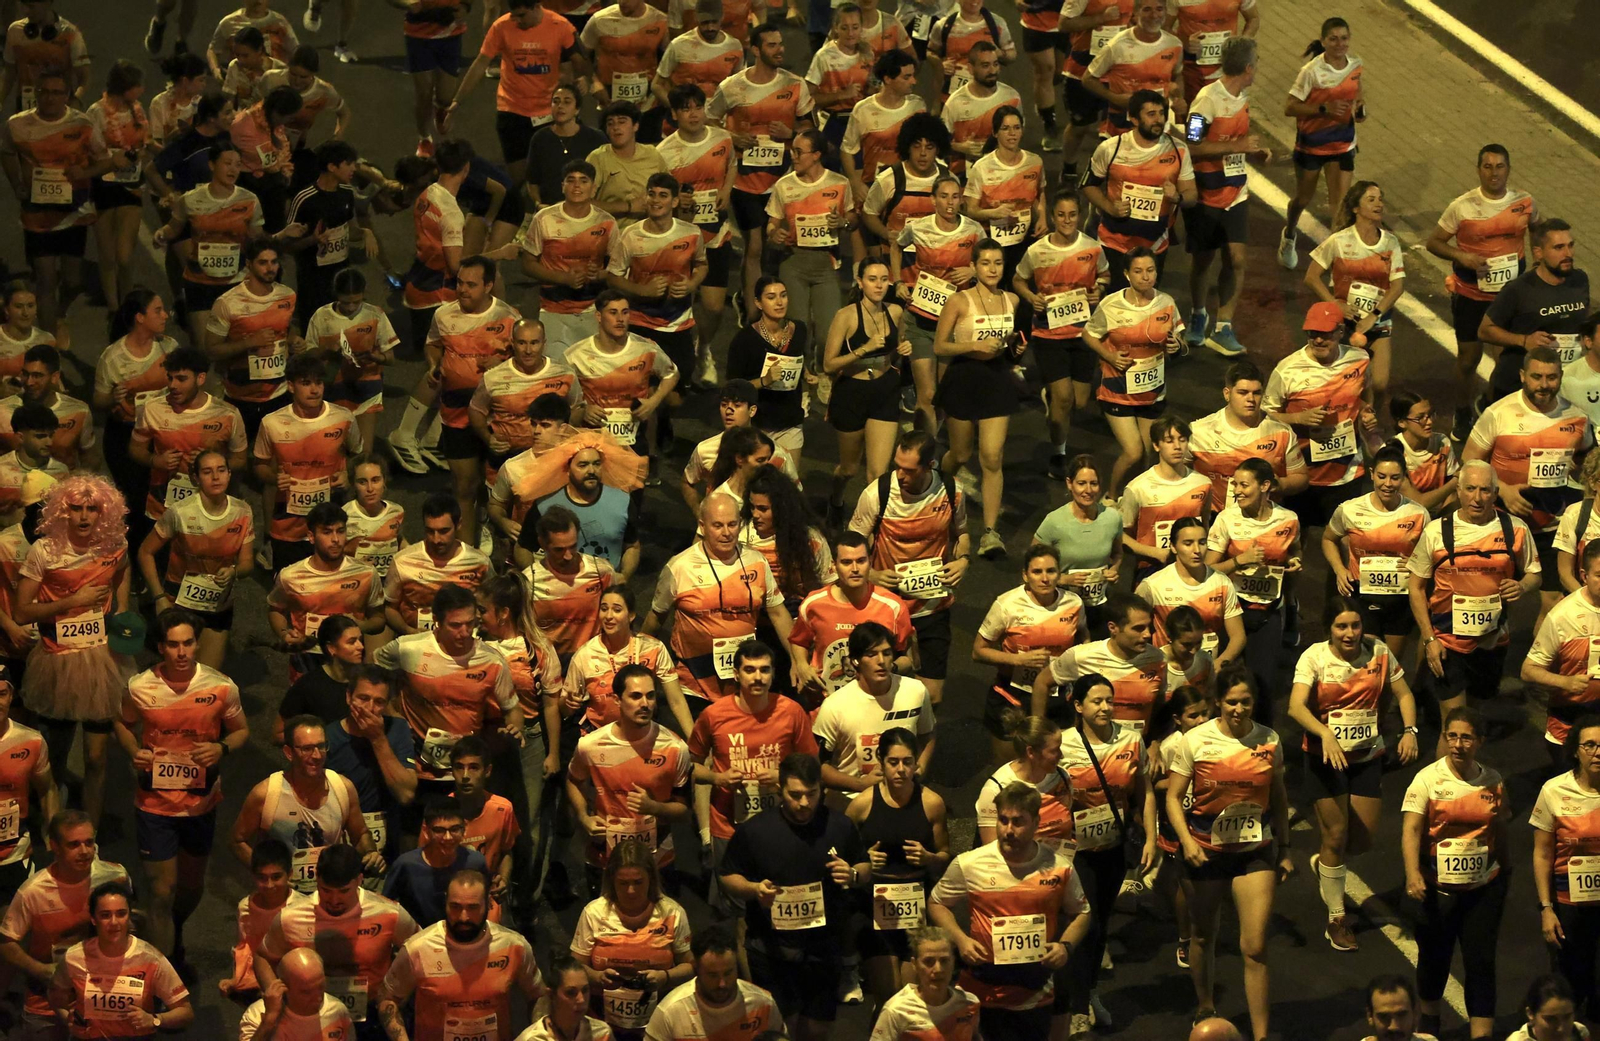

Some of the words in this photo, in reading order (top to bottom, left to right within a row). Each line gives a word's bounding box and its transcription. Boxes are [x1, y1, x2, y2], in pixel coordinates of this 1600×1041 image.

[617, 85, 641, 97] 5613
[748, 147, 779, 159] 21375
[40, 184, 63, 195] 635
[202, 256, 234, 268] 23852
[918, 285, 946, 306] 19383
[1052, 302, 1084, 319] 19382
[1540, 303, 1585, 316] CARTUJA
[254, 355, 284, 370] 17005
[1134, 369, 1158, 382] 8762
[203, 422, 223, 432] KH7
[324, 430, 342, 439] KH7
[1257, 441, 1277, 451] KH7
[1320, 436, 1346, 449] 3687
[1535, 464, 1566, 477] 16057
[291, 492, 325, 505] 14948
[1397, 522, 1415, 530] KH7
[904, 575, 939, 589] 12546
[1242, 578, 1270, 592] 3800
[1369, 573, 1398, 585] 3941
[341, 582, 360, 590] KH7
[186, 584, 220, 602] 12938
[1462, 612, 1492, 624] 3194
[62, 622, 100, 636] 22498
[466, 672, 486, 681] KH7
[195, 695, 216, 704] KH7
[1334, 726, 1372, 739] 21290
[728, 733, 744, 746] VI
[11, 750, 30, 759] KH7
[644, 756, 666, 765] KH7
[158, 763, 199, 779] 20790
[1217, 817, 1254, 832] 17175
[1444, 857, 1482, 872] 12039
[777, 901, 816, 916] 14197
[880, 903, 918, 915] 13631
[999, 936, 1040, 950] 17916
[487, 960, 509, 969] KH7
[609, 1001, 649, 1014] 14587
